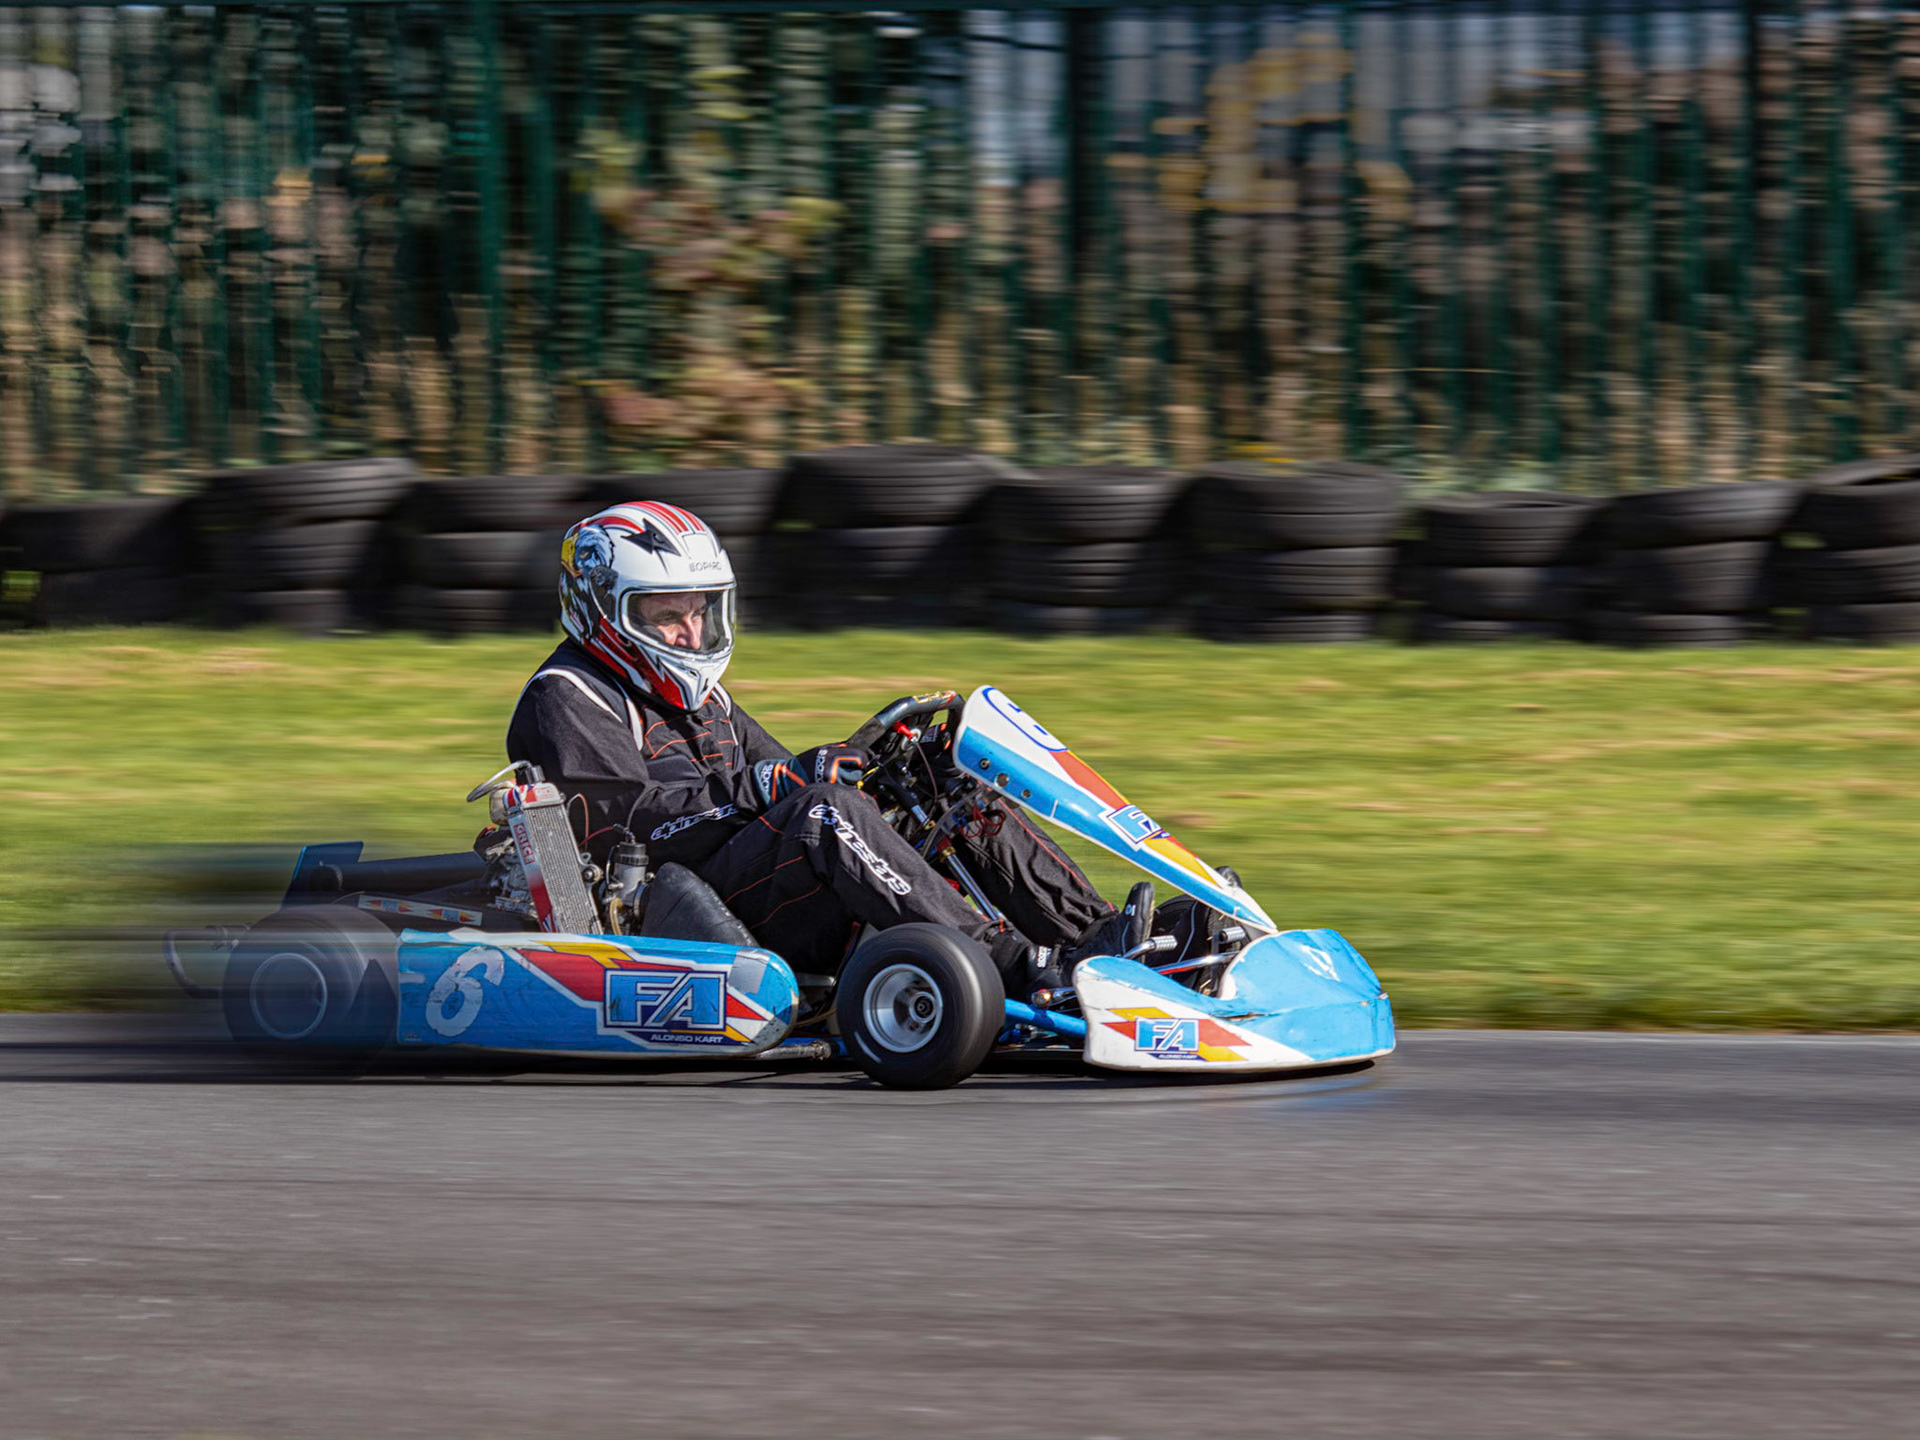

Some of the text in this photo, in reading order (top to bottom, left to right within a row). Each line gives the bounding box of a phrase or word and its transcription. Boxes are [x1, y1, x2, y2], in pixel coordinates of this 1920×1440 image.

[425, 946, 505, 1037] 6
[605, 969, 726, 1030] FA
[650, 1034, 724, 1044] ALONSO KART
[1135, 1018, 1199, 1051] FA
